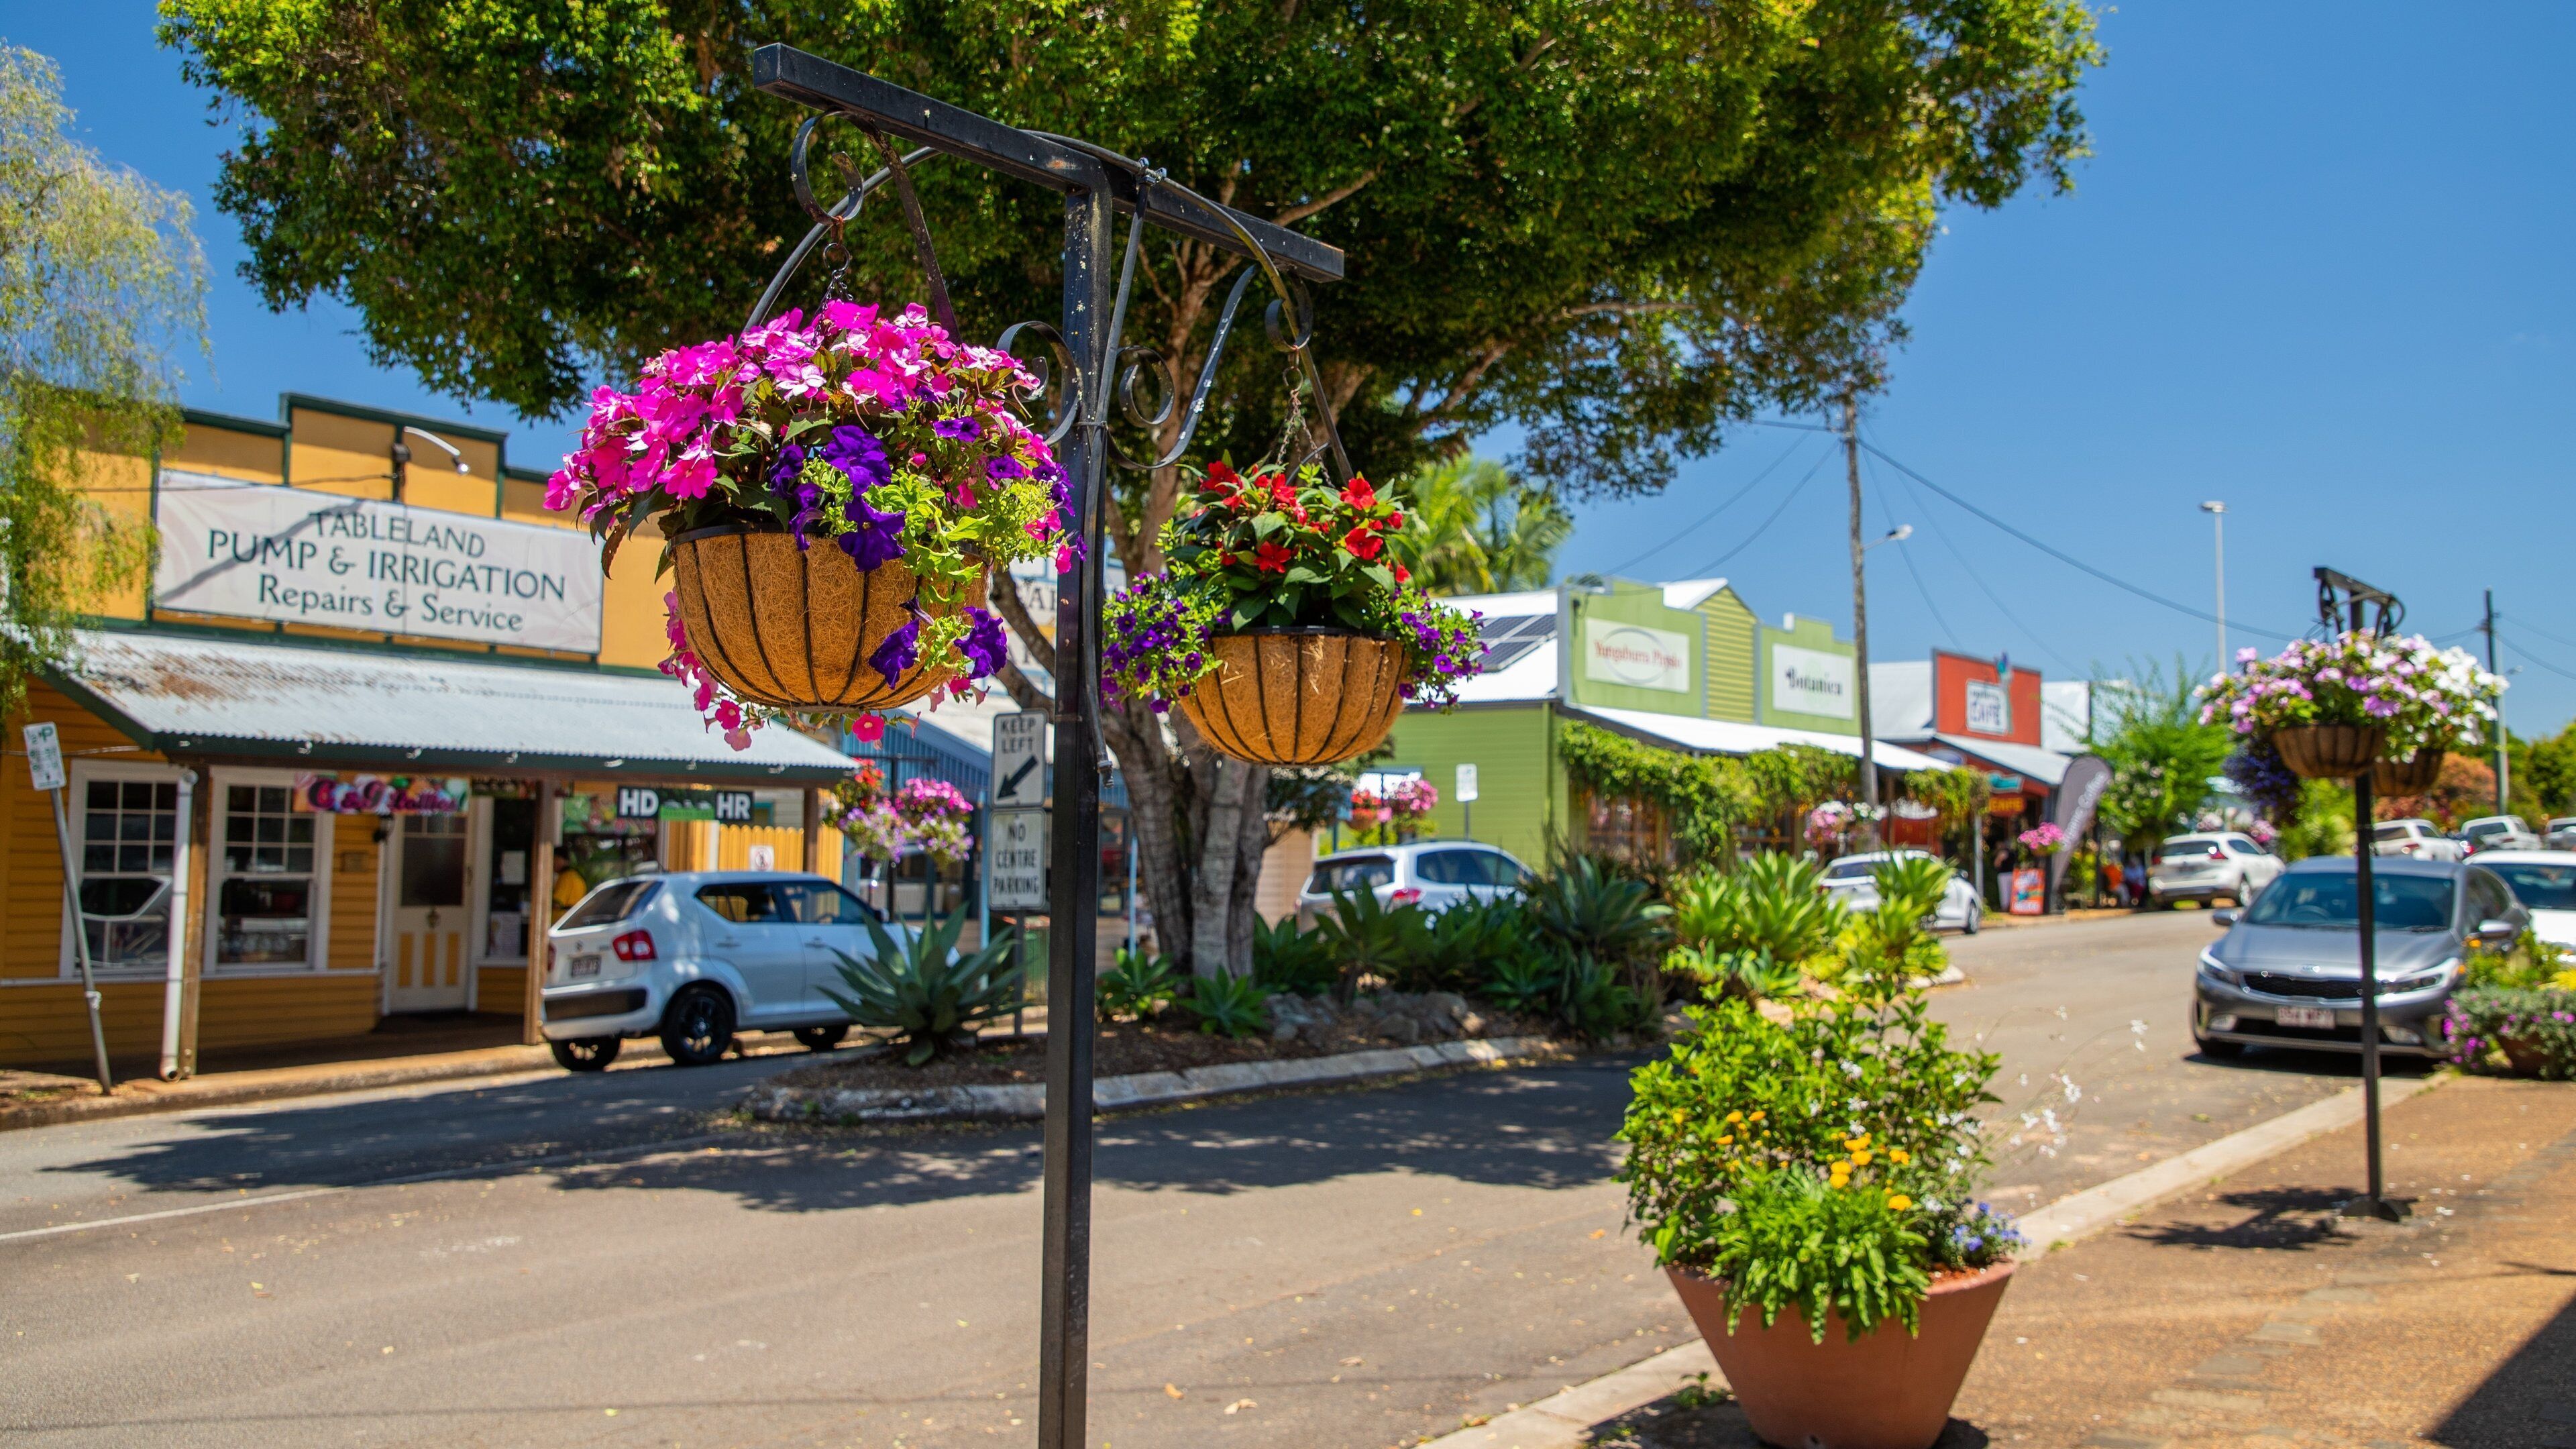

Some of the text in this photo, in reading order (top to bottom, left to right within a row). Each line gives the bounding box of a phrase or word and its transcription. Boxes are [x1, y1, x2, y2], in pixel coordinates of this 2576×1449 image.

[307, 511, 486, 558] TABLELAND
[209, 527, 566, 602] PUMP & IRRIGATION
[259, 573, 524, 632] Repairs & Service
[1000, 717, 1036, 733] KEEP
[1001, 737, 1033, 753] LEFT
[619, 788, 659, 817] HD
[716, 792, 751, 820] HR
[1007, 823, 1026, 842] NO
[995, 849, 1037, 869] CENTRE
[993, 875, 1039, 894] PARKING
